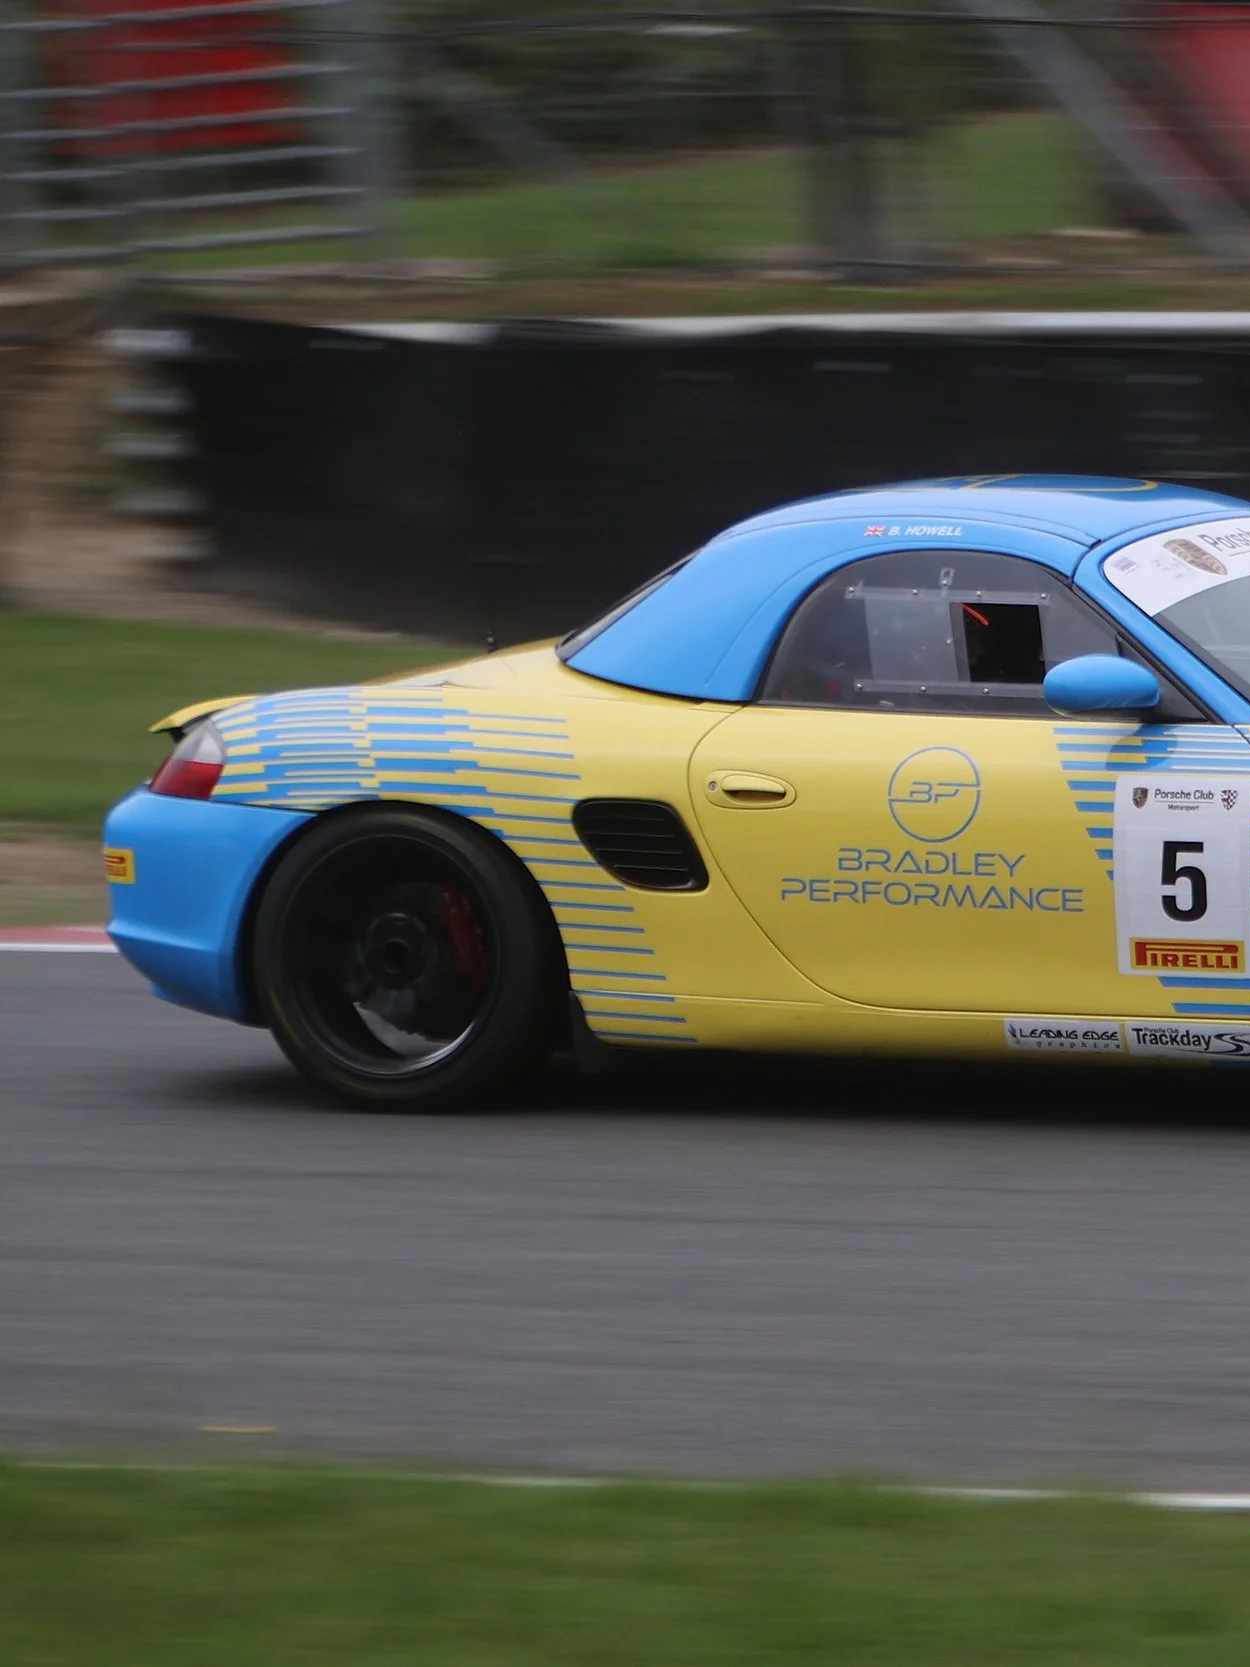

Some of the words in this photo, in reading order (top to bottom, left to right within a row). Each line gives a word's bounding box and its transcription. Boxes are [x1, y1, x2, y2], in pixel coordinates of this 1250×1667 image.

[905, 526, 962, 536] HOWELL
[1154, 789, 1192, 800] Porsche
[1193, 790, 1215, 800] Club
[1167, 804, 1200, 812] Motorsport
[838, 848, 1025, 878] BRADLEY
[1161, 840, 1208, 922] 5
[781, 878, 1085, 912] PERFORMANCE
[1134, 941, 1239, 969] PIRELLI
[1019, 1028, 1079, 1040] LEADING
[1081, 1030, 1119, 1041] EDGE
[1131, 1028, 1212, 1051] Trackday
